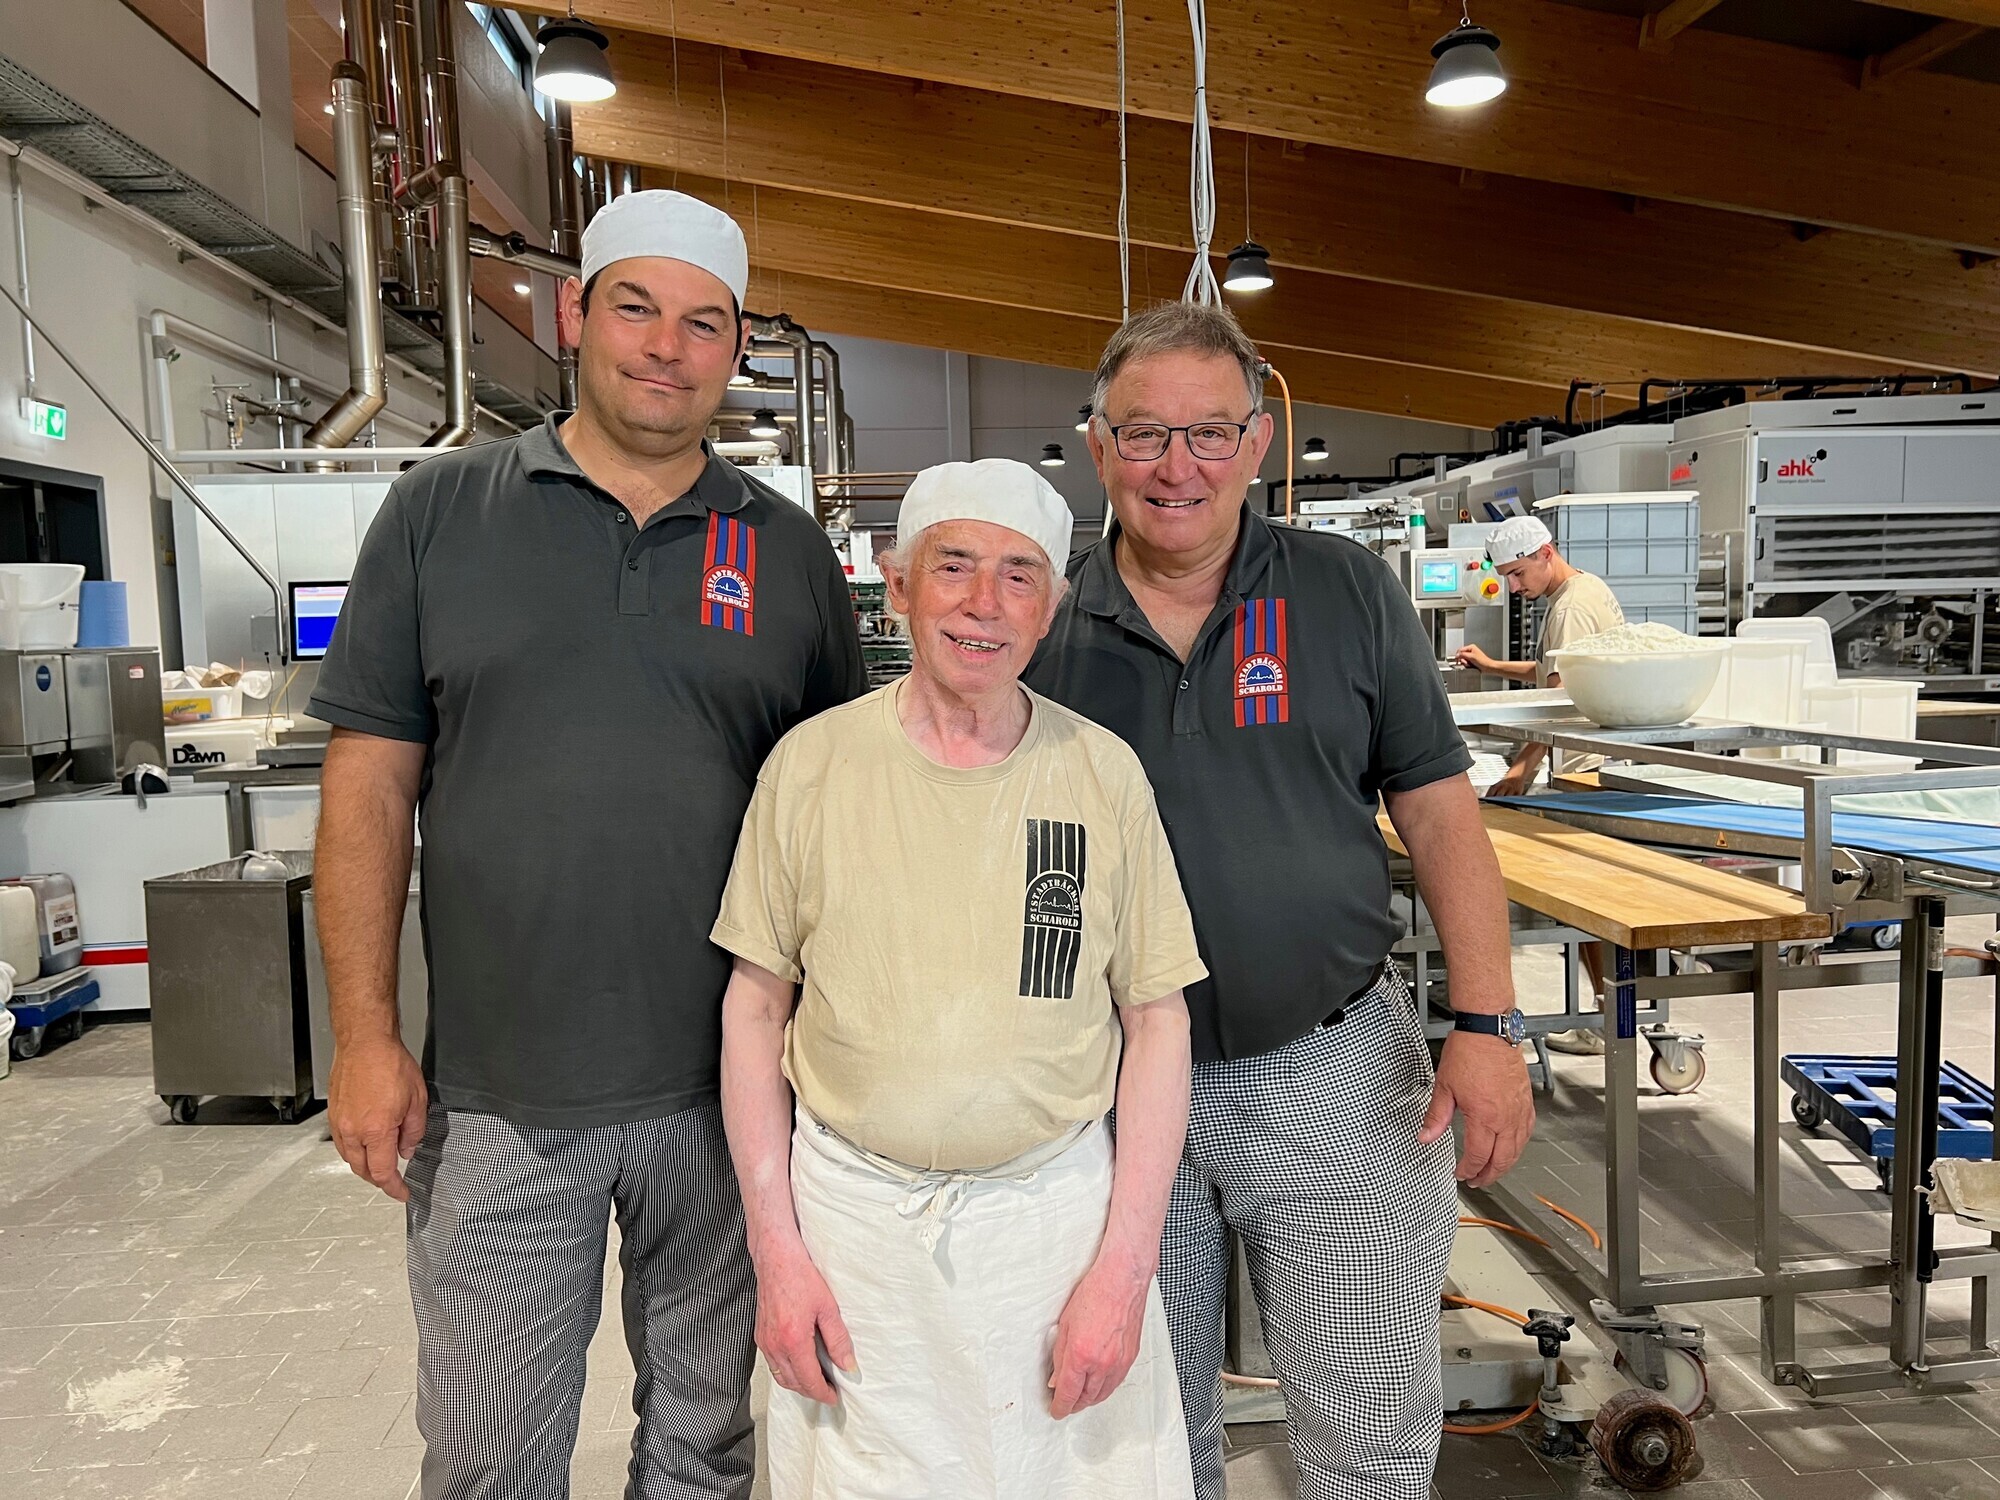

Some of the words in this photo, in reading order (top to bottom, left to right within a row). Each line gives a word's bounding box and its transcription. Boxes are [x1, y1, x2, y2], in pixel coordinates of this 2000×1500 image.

[1777, 459, 1814, 476] ahk
[706, 592, 750, 609] SCHAROLD
[1238, 684, 1284, 696] SCHAROLD
[173, 746, 226, 764] Dawn
[1030, 878, 1080, 912] STADTBÄCKER
[1029, 913, 1080, 928] SCHAROLD
